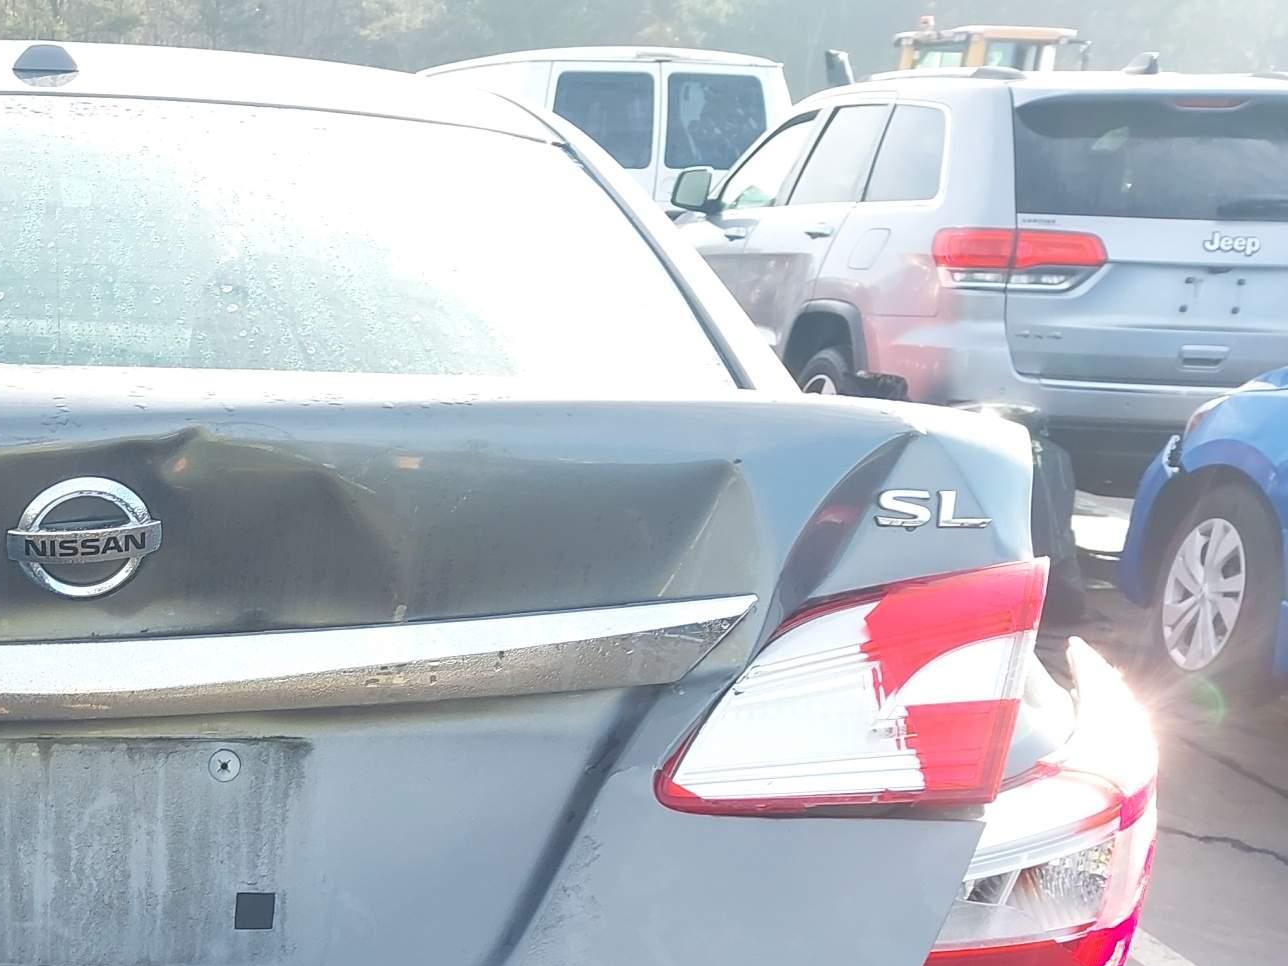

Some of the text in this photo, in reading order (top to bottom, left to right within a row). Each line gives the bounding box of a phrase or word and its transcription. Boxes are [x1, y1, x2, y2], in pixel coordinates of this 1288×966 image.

[1203, 231, 1261, 257] Jeep
[874, 488, 993, 530] SL
[24, 531, 146, 557] NISSAN
